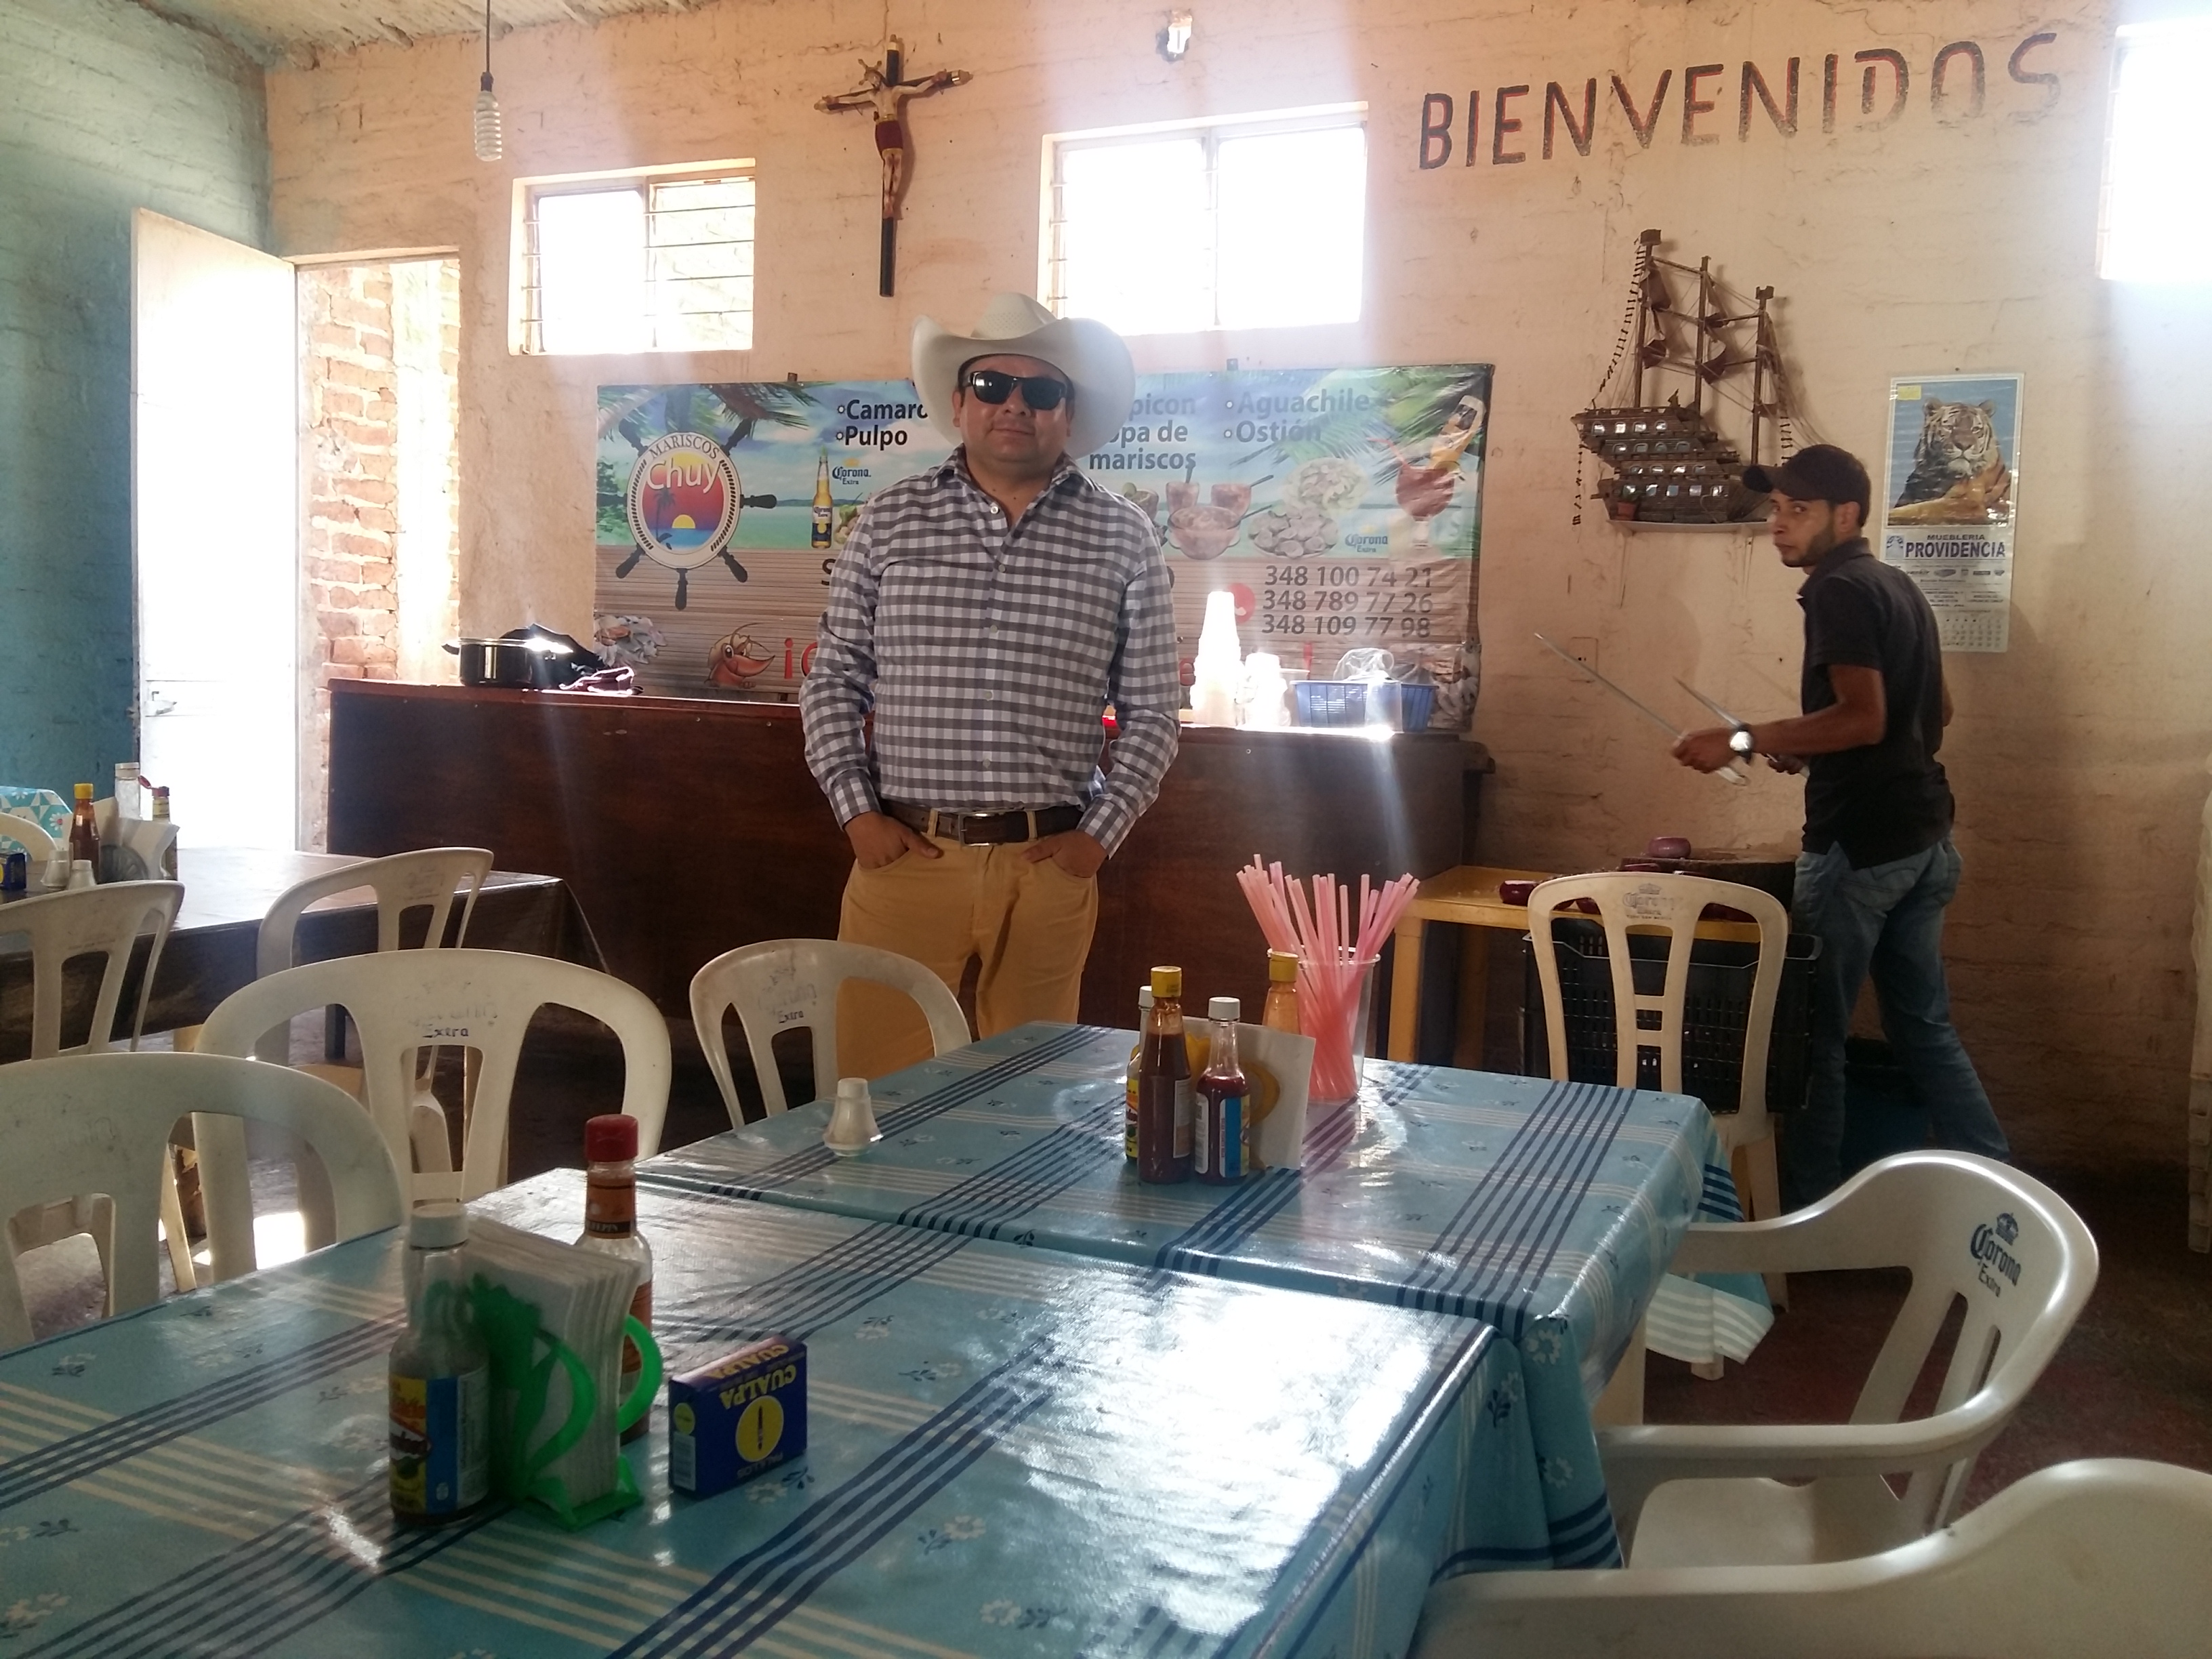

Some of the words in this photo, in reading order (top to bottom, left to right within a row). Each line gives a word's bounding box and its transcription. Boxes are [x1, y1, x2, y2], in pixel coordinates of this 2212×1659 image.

[1419, 32, 2062, 169] BIENVENIDOS
[846, 398, 928, 419] Camaro
[1128, 393, 1196, 421] picon
[1237, 388, 1370, 419] Aguachile
[844, 425, 908, 451] Pulpo
[1158, 419, 1188, 442] de
[1236, 419, 1322, 443] Ostión
[649, 434, 720, 459] MARISCOS
[1089, 447, 1196, 470] mariscos
[647, 457, 722, 494] Chuy
[832, 466, 870, 480] Corona
[1345, 533, 1388, 548] Corona
[1905, 541, 2006, 558] PROVIDENCIA
[1265, 565, 1308, 586] 348
[1317, 566, 1359, 587] 100
[1367, 567, 1397, 587] 74
[1405, 567, 1431, 588] 21
[1262, 590, 1307, 611] 348
[1314, 591, 1359, 611] 789
[1366, 592, 1395, 613] 77
[1402, 593, 1433, 613] 26
[1261, 614, 1305, 635] 348
[1315, 616, 1357, 636] 109
[1364, 617, 1393, 636] 77
[1401, 617, 1431, 638] 98
[1970, 1223, 2022, 1286] Corona
[1978, 1263, 2001, 1298] Extra
[703, 1345, 790, 1379] CUALPA
[718, 1364, 797, 1410] CUALPA
